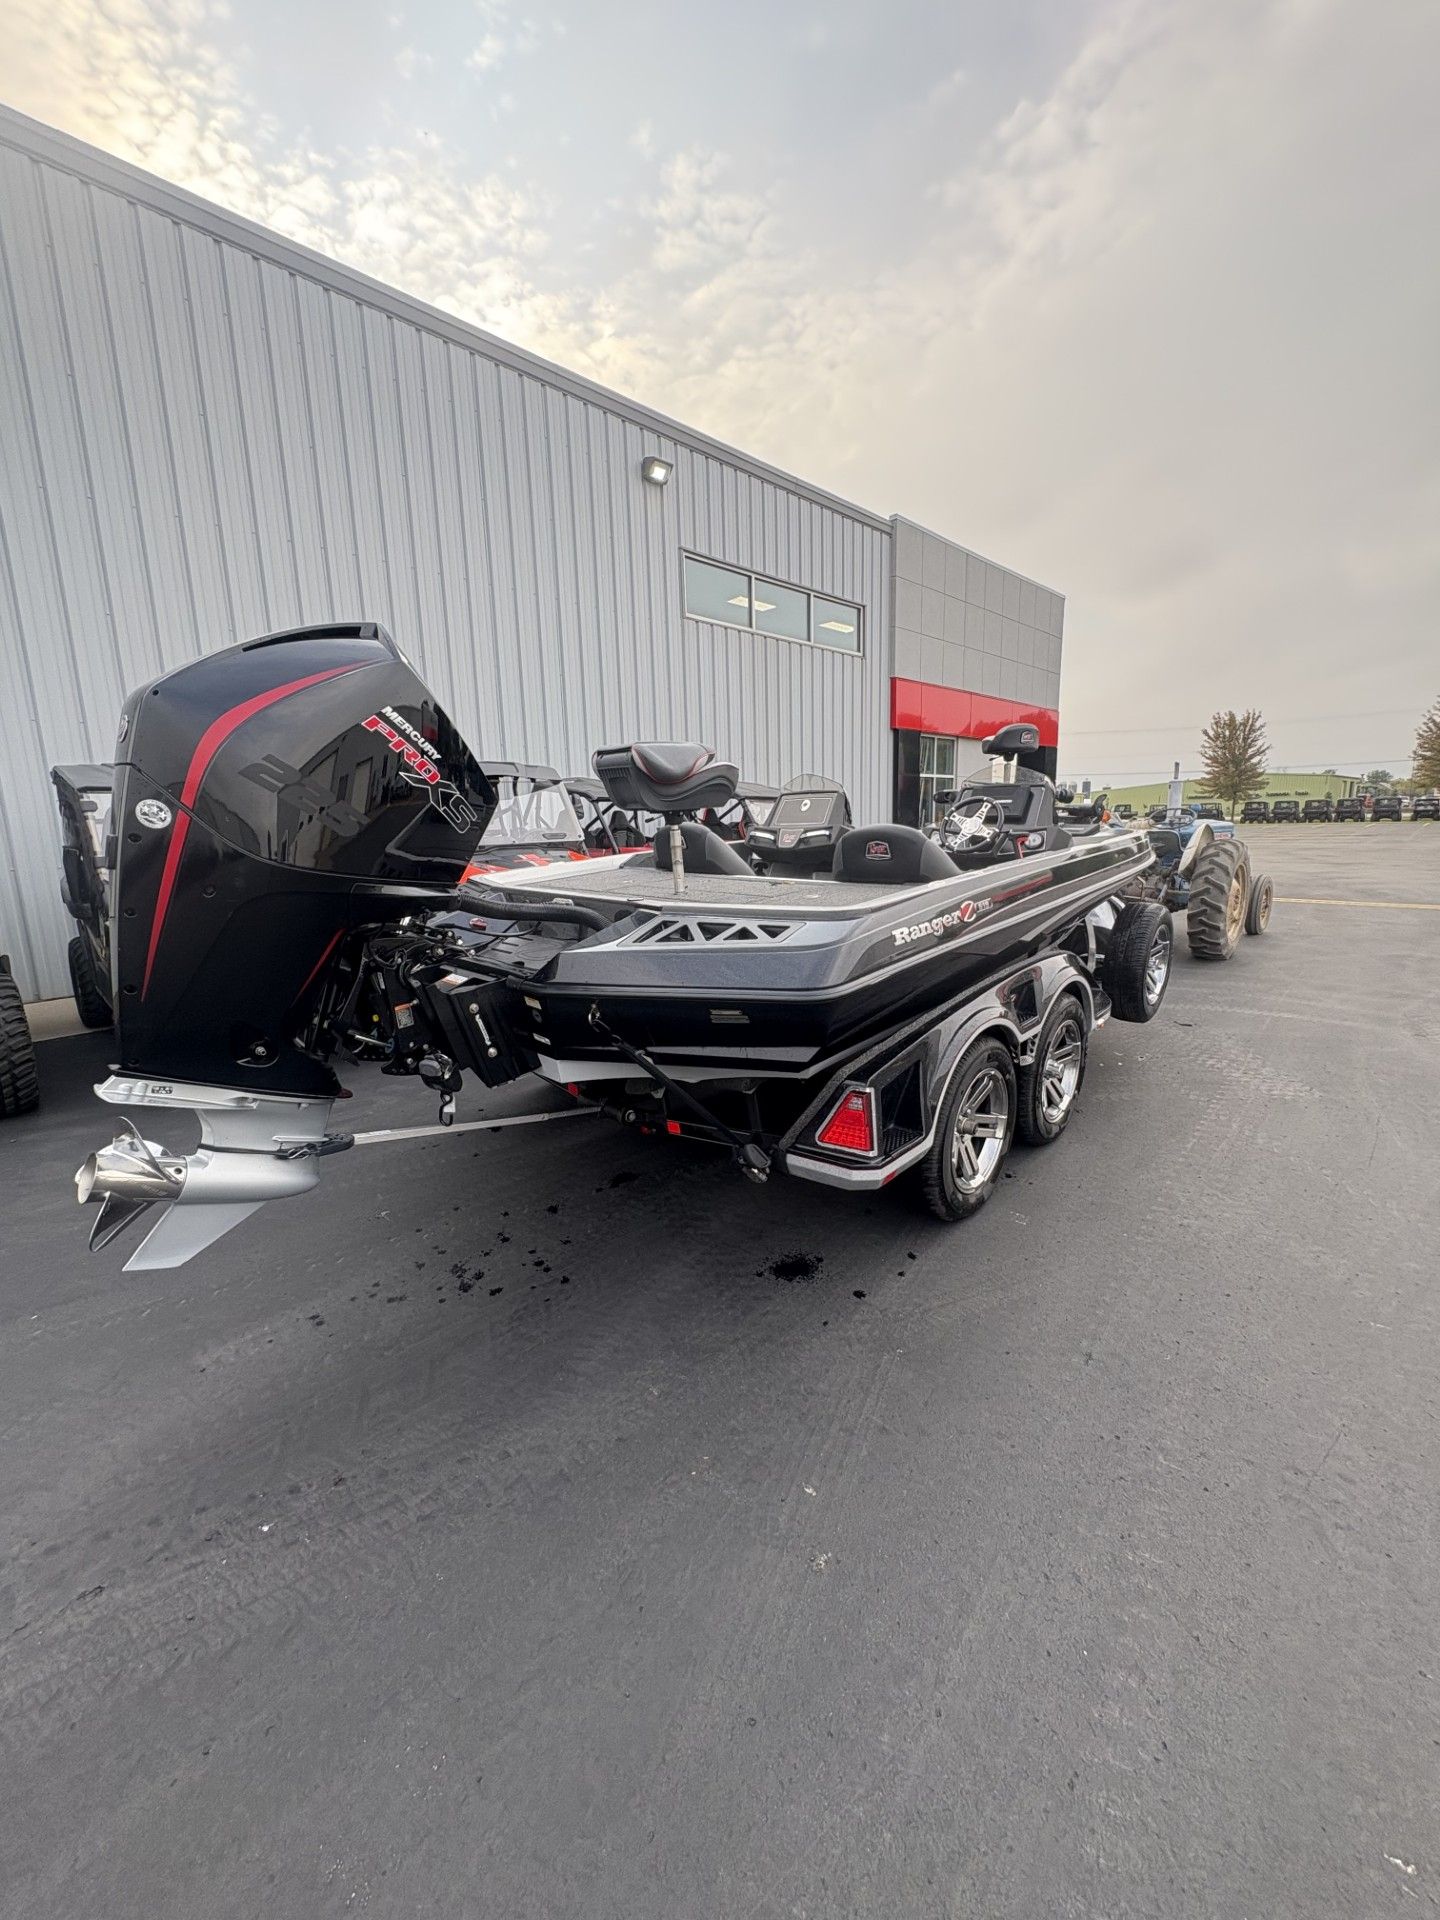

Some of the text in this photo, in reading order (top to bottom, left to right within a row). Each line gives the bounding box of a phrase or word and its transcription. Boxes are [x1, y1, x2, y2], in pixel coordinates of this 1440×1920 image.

[381, 705, 442, 760] MERCURY
[238, 754, 371, 837] 225
[361, 715, 478, 834] PRO XS
[892, 911, 962, 945] Ranger
